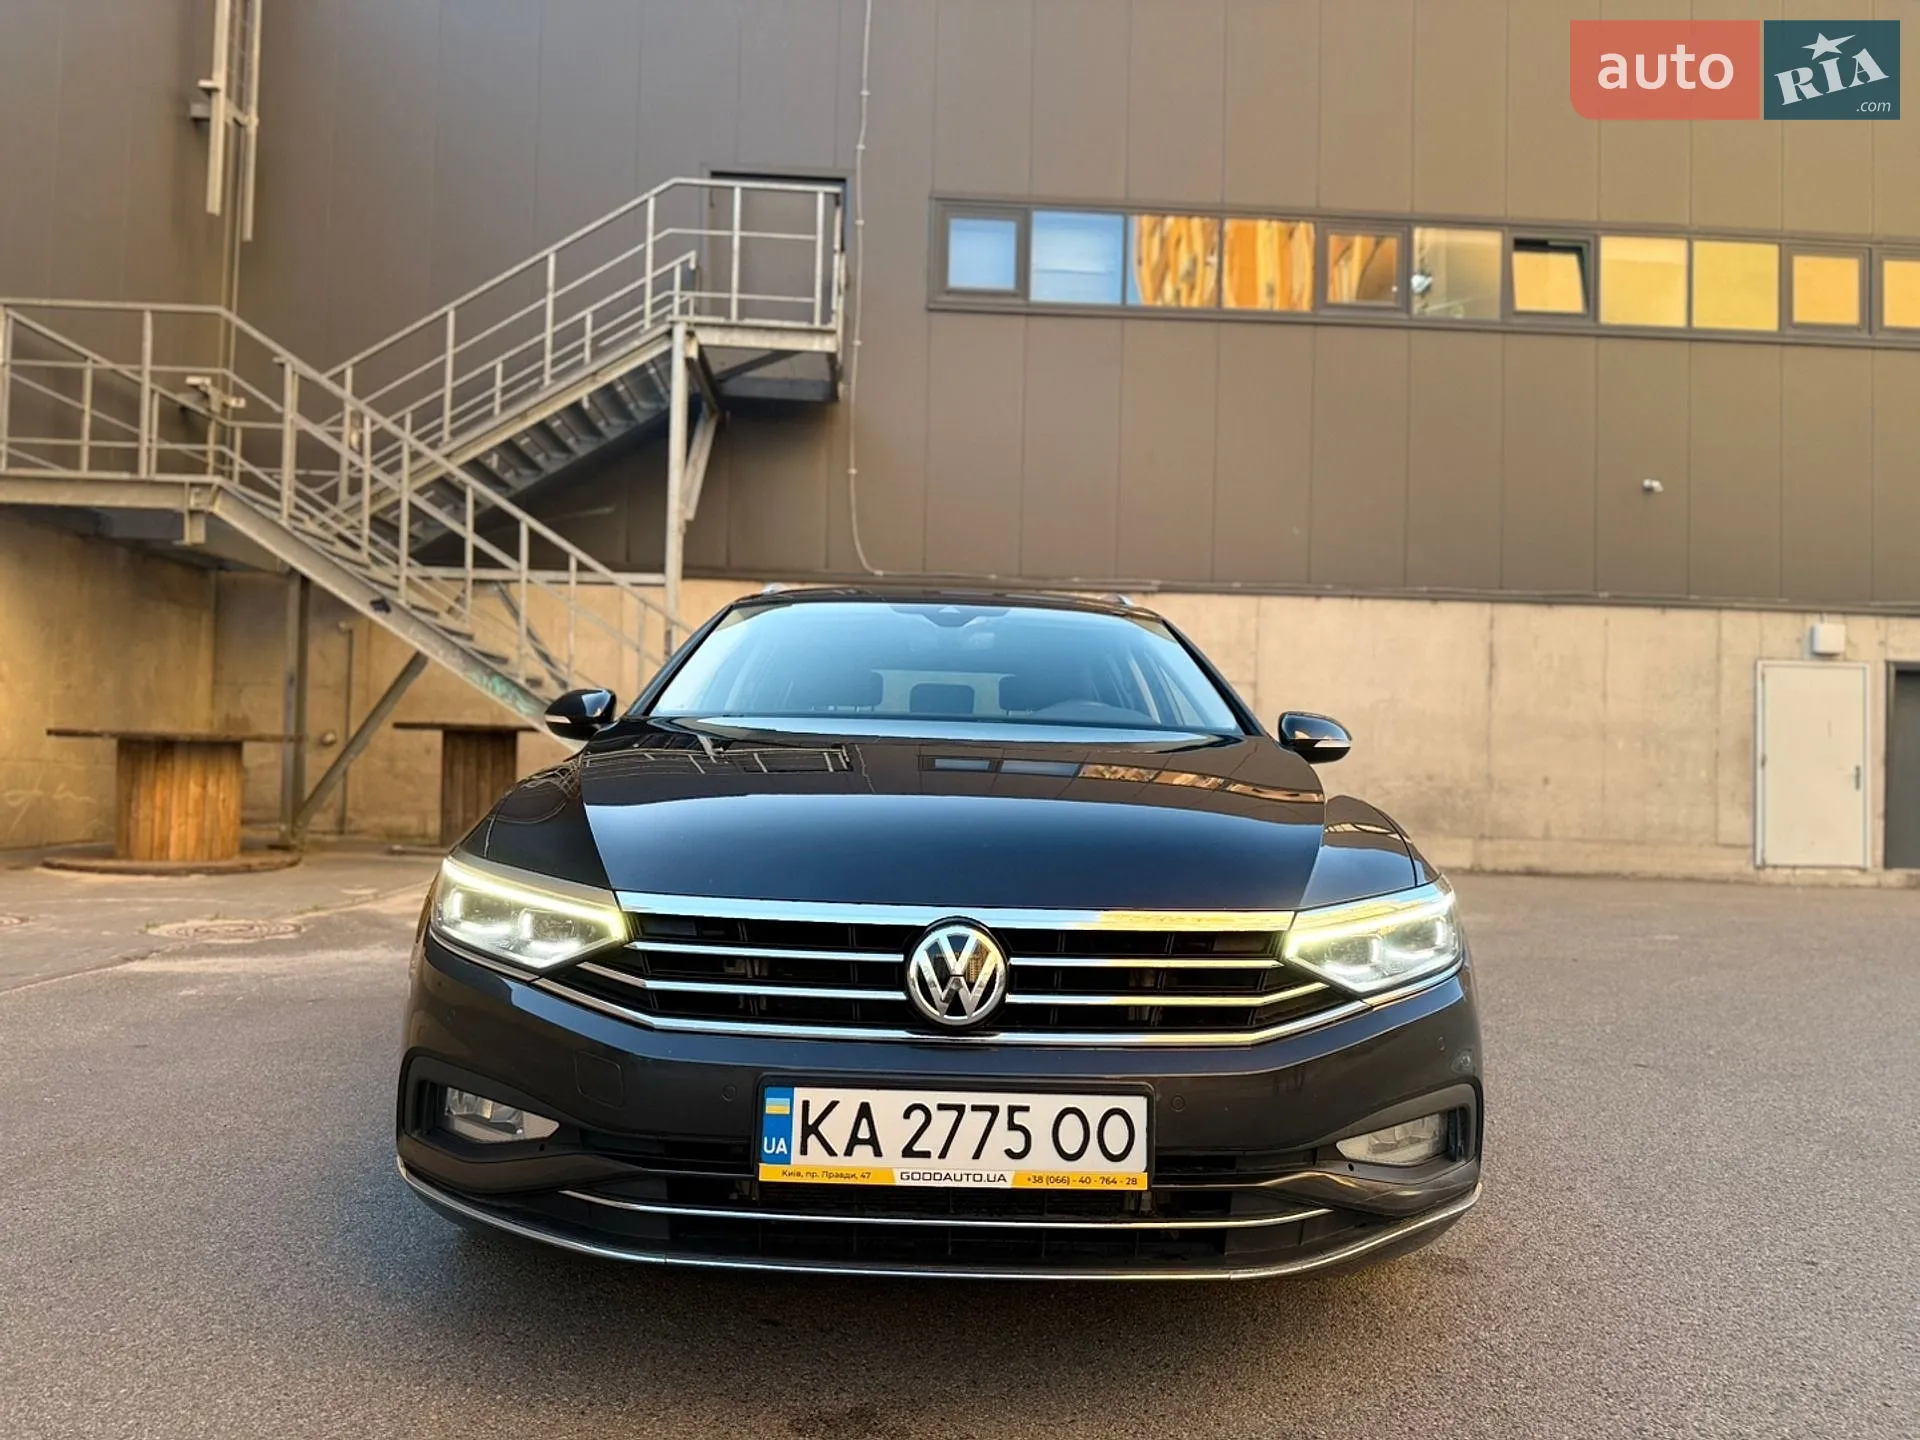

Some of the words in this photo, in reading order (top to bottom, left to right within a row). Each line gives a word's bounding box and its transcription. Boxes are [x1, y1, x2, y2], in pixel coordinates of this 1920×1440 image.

[800, 1100, 883, 1158] KA
[901, 1103, 1032, 1160] 2775
[763, 1136, 787, 1155] UA
[805, 1171, 820, 1180] пр.
[821, 1170, 858, 1180] Правди,
[860, 1172, 872, 1180] 47
[900, 1171, 1008, 1183] GOODAUTO.UA
[1027, 1175, 1044, 1184] +38
[1045, 1175, 1071, 1186] (066)
[1078, 1176, 1092, 1185] 40
[1099, 1176, 1118, 1185] 764
[1125, 1177, 1138, 1185] 28
